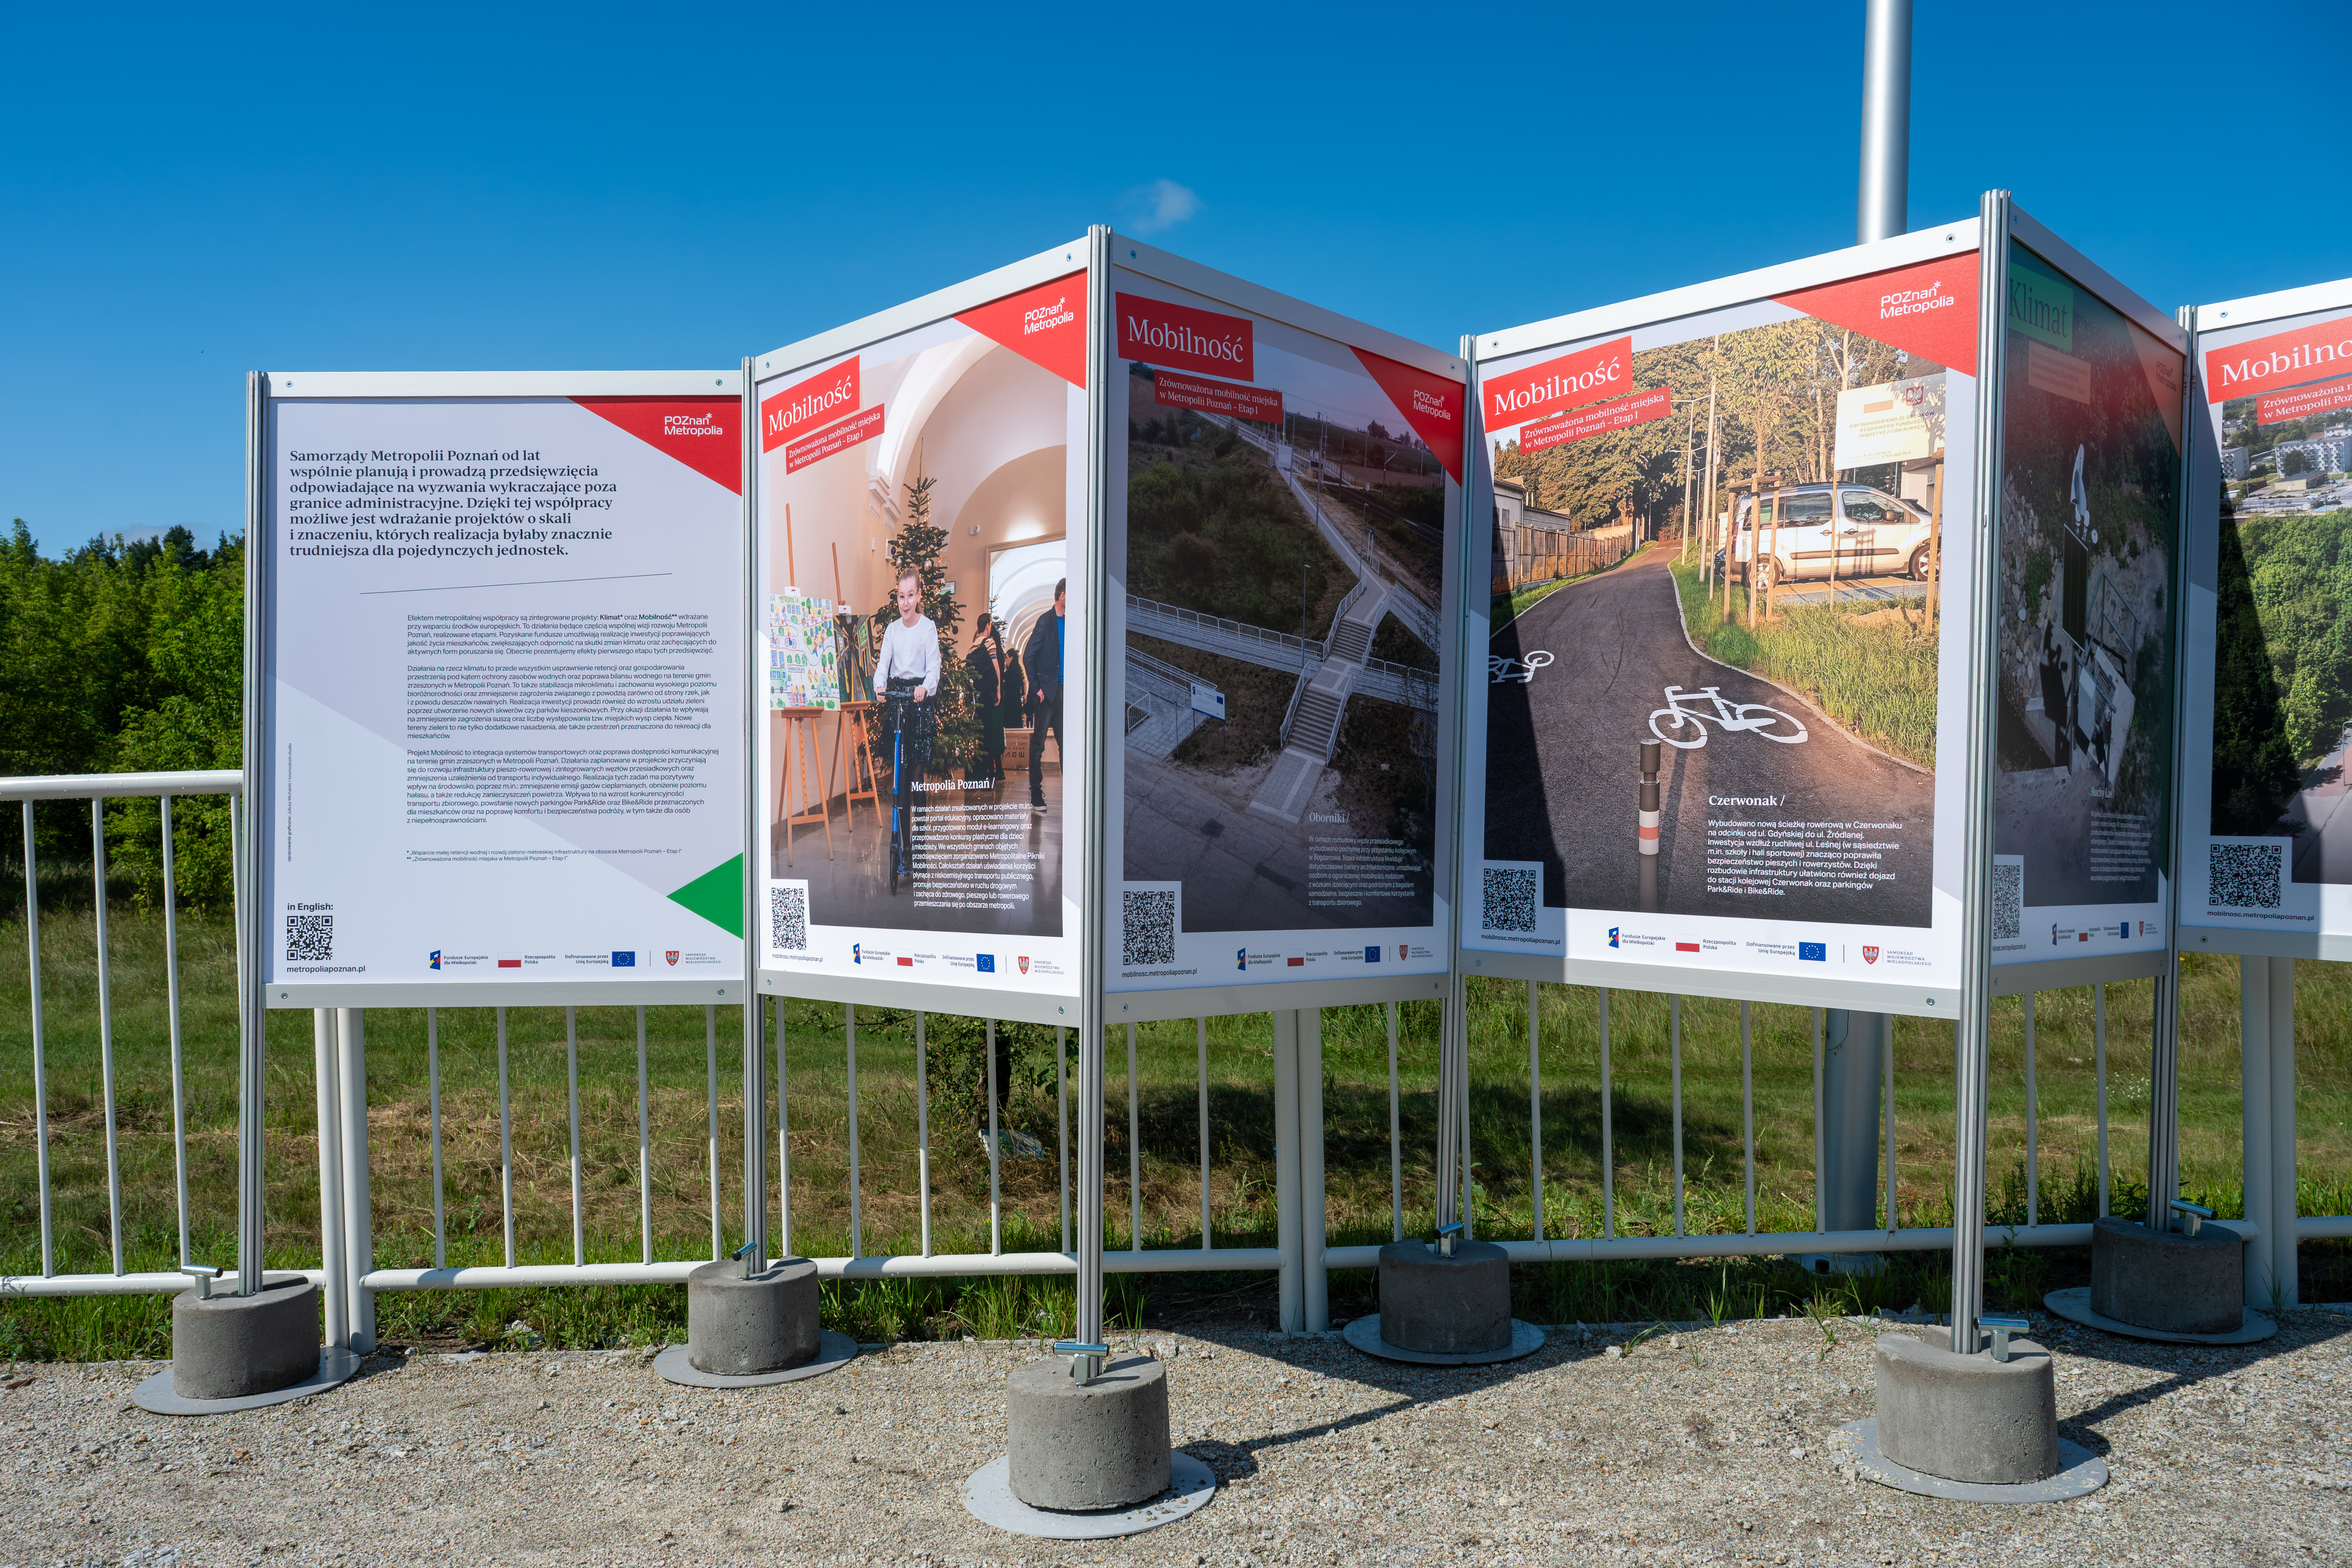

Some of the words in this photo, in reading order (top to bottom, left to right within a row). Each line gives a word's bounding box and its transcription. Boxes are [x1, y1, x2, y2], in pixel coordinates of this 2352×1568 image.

[1880, 295, 1954, 319] Metropolia
[2009, 278, 2068, 338] Klimat
[1024, 312, 1073, 335] Metropolia
[1128, 315, 1244, 362] Mobilność
[1494, 356, 1620, 416] Mobilność
[2155, 371, 2176, 391] Metropolia
[1159, 377, 1213, 395] Zrównoważona
[1215, 389, 1251, 402] mobilność
[1252, 395, 1278, 406] miejska
[2263, 386, 2344, 408] Zrównoważona
[768, 375, 851, 436] Mobilność
[1168, 391, 1205, 406] Metropolii
[1207, 398, 1232, 410] Poznań
[1239, 403, 1254, 415] Etap
[1255, 406, 1258, 414] I
[1414, 400, 1451, 420] Metropolia
[2275, 397, 2331, 416] Metropolii
[1525, 417, 1584, 439] Zrównoważona
[1586, 402, 1629, 421] mobilność
[1631, 395, 1664, 414] miejska
[1849, 417, 1898, 429] DOFINANSOWANO
[1896, 418, 1925, 427] FUNDUSZU
[665, 425, 723, 436] Metropolia
[789, 436, 827, 458] Zrównoważona
[828, 423, 857, 441] mobilność
[858, 413, 880, 427] miejska
[1534, 428, 1574, 447] Metropolii
[1576, 420, 1605, 435] Poznań
[1614, 414, 1633, 425] Etap
[1635, 411, 1638, 419] I
[1892, 424, 1925, 433] LOKALNYCH
[794, 447, 821, 466] Metropolii
[822, 440, 841, 454] Poznań
[847, 432, 860, 443] Etap
[290, 450, 368, 464] Samorządy
[371, 450, 444, 463] Metropolii
[447, 450, 499, 461] Poznań
[502, 450, 519, 461] od
[523, 450, 541, 460] lat
[290, 466, 352, 479] wspólnie
[356, 466, 408, 479] planują
[412, 466, 416, 477] i
[420, 466, 486, 479] prowadzą
[489, 465, 598, 479] przedsięwzięcia
[290, 481, 394, 495] odpowiadające
[397, 484, 414, 493] na
[418, 481, 486, 495] wyzwania
[489, 481, 581, 495] wykraczające
[584, 484, 617, 494] poza
[290, 497, 342, 511] granice
[346, 497, 463, 511] administracyjne.
[467, 497, 510, 511] Dzięki
[514, 497, 531, 510] tej
[534, 497, 613, 510] współpracy
[290, 513, 348, 524] możliwe
[350, 513, 376, 527] jest
[379, 513, 451, 524] wdrażanie
[455, 512, 524, 526] projektów
[539, 512, 571, 524] skali
[290, 529, 294, 540] i
[298, 529, 372, 542] znaczeniu,
[376, 529, 429, 542] których
[433, 529, 499, 542] realizacja
[503, 529, 548, 542] byłaby
[551, 528, 612, 539] znacznie
[290, 545, 369, 558] trudniejsza
[373, 545, 394, 556] dla
[398, 545, 493, 558] pojedynczych
[495, 544, 568, 558] jednostek.
[911, 779, 956, 792] Metropolia
[957, 777, 990, 790] Poznań
[1709, 795, 1778, 806] Czerwonak
[1309, 812, 1346, 823] Oborniki
[1708, 819, 1756, 828] Wybudowano
[1778, 820, 1805, 829] ścieżkę
[1707, 885, 1743, 893] Park&Ride
[1748, 887, 1785, 895] Bike&Ride.
[298, 903, 333, 912] English:
[988, 902, 1015, 911] metropolii.
[2207, 911, 2314, 922] mobilnosc.metropoliapoznan.pl
[1481, 934, 1560, 945] mobilnosc.metropoliapoznan.pl
[287, 965, 366, 974] metropoliapoznan.pl
[1122, 968, 1197, 978] mobilnosc.metropoliapoznan.pl
